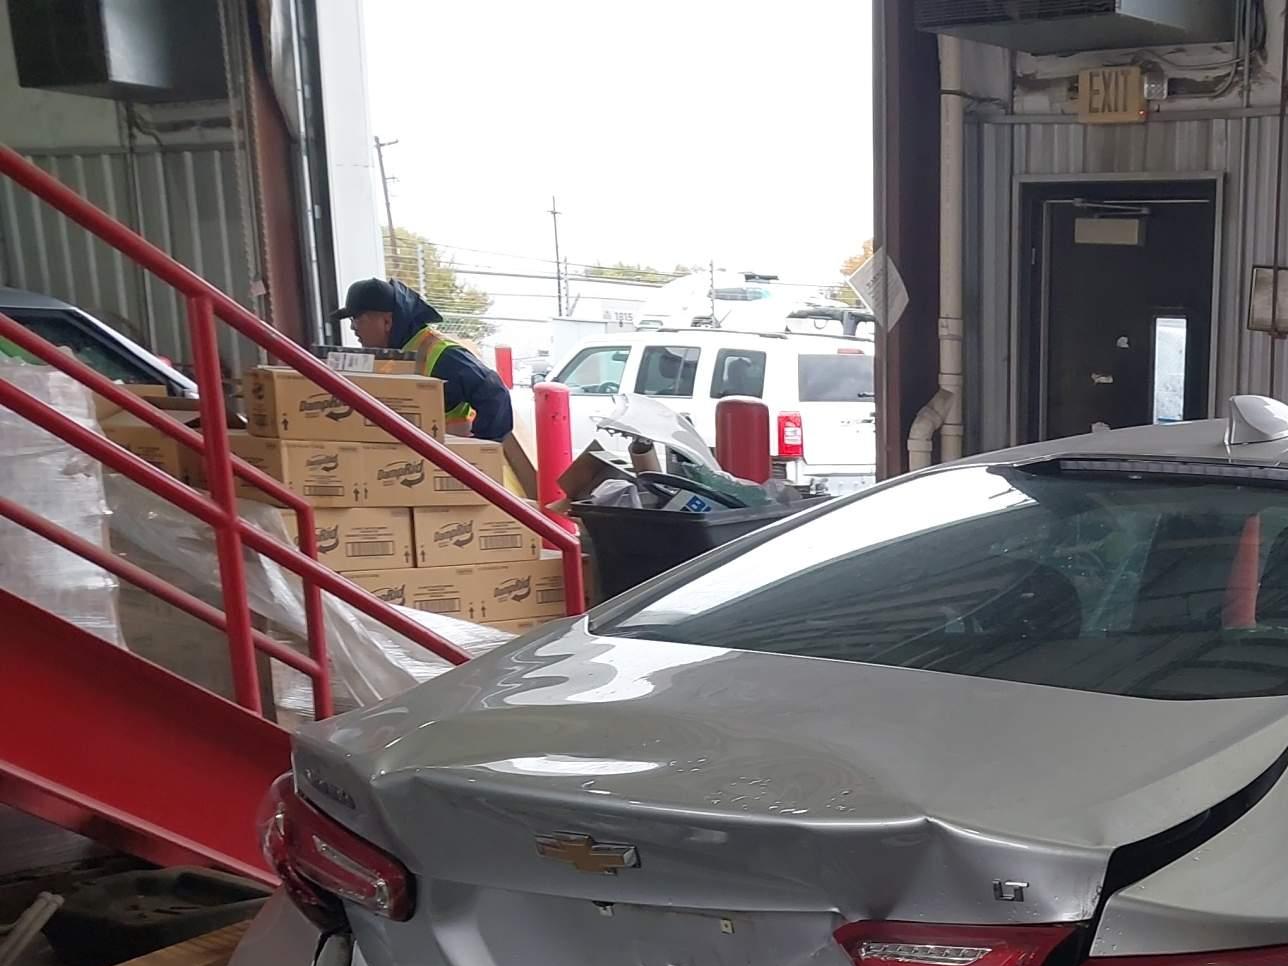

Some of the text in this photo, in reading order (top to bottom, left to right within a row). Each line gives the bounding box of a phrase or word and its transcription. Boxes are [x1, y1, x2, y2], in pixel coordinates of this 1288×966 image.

[1089, 69, 1132, 113] EXIT
[377, 459, 424, 481] DampRid
[434, 520, 474, 543] DampRid
[493, 576, 531, 598] DampRid
[992, 879, 1030, 902] LT
